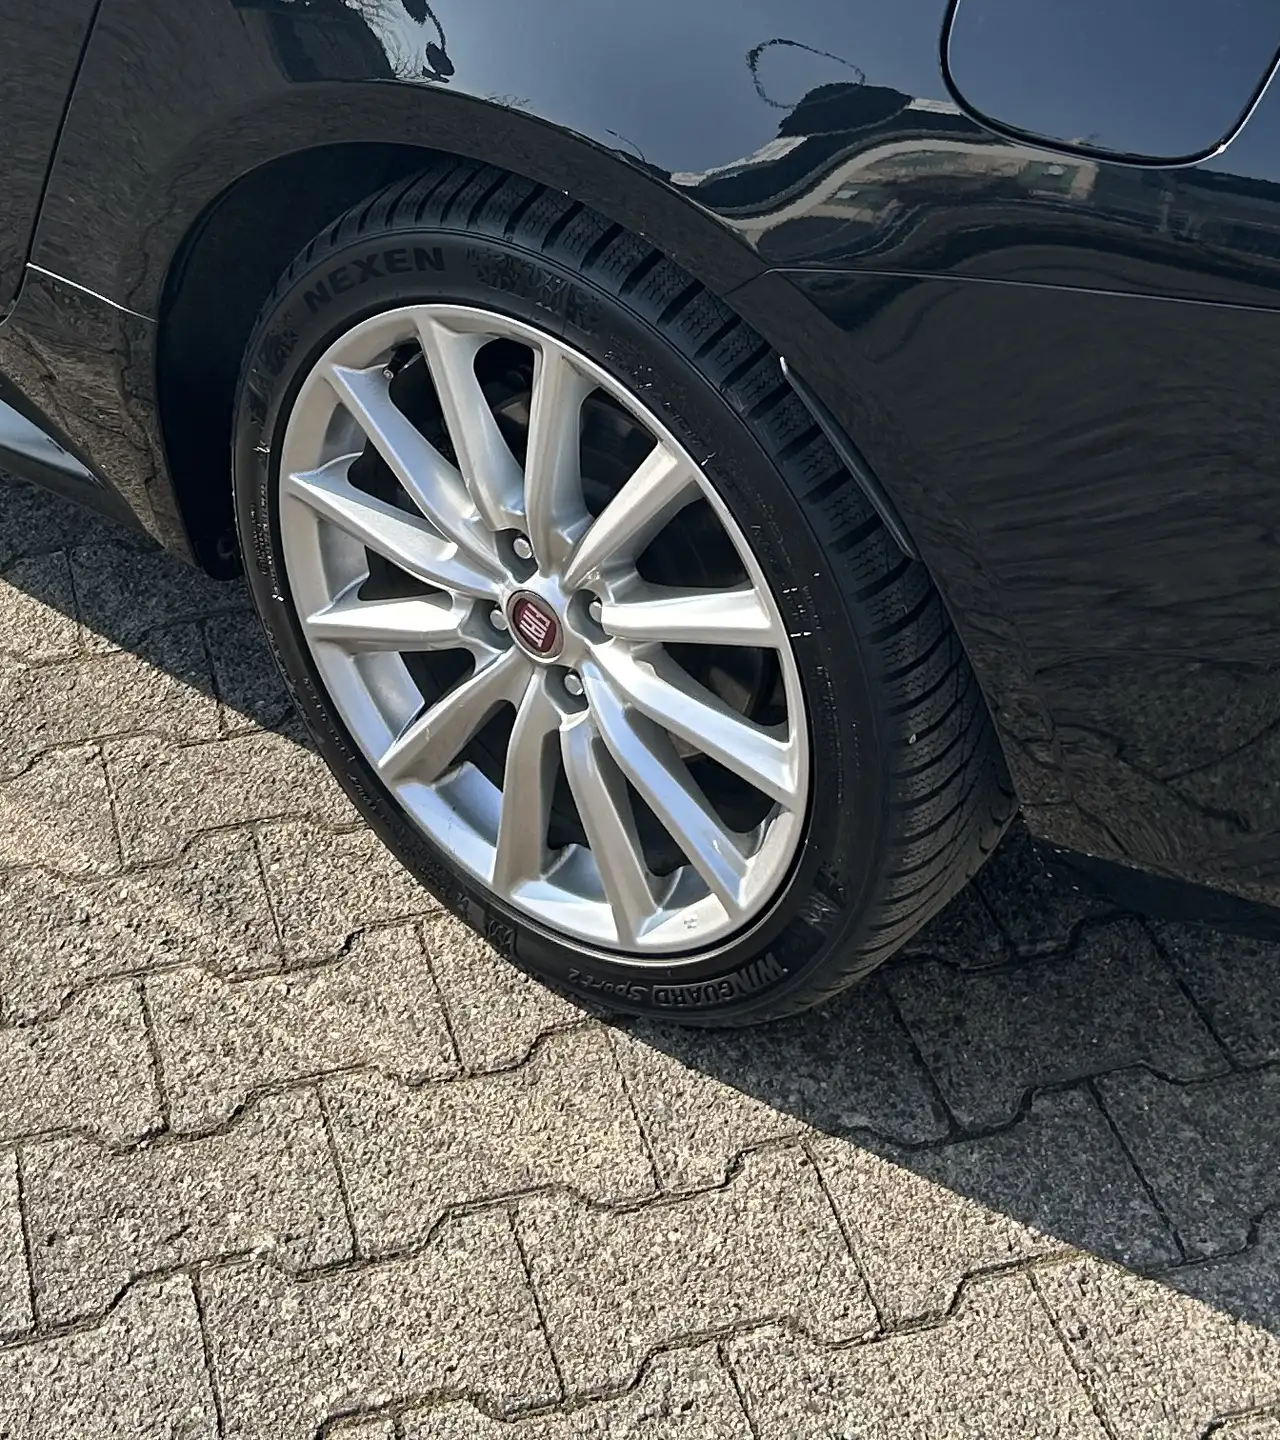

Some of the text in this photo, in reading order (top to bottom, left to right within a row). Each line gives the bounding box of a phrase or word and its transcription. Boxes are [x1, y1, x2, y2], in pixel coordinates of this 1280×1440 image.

[302, 244, 446, 316] NEXEN
[518, 602, 552, 649] FIAT
[652, 950, 784, 1009] WINGUARD
